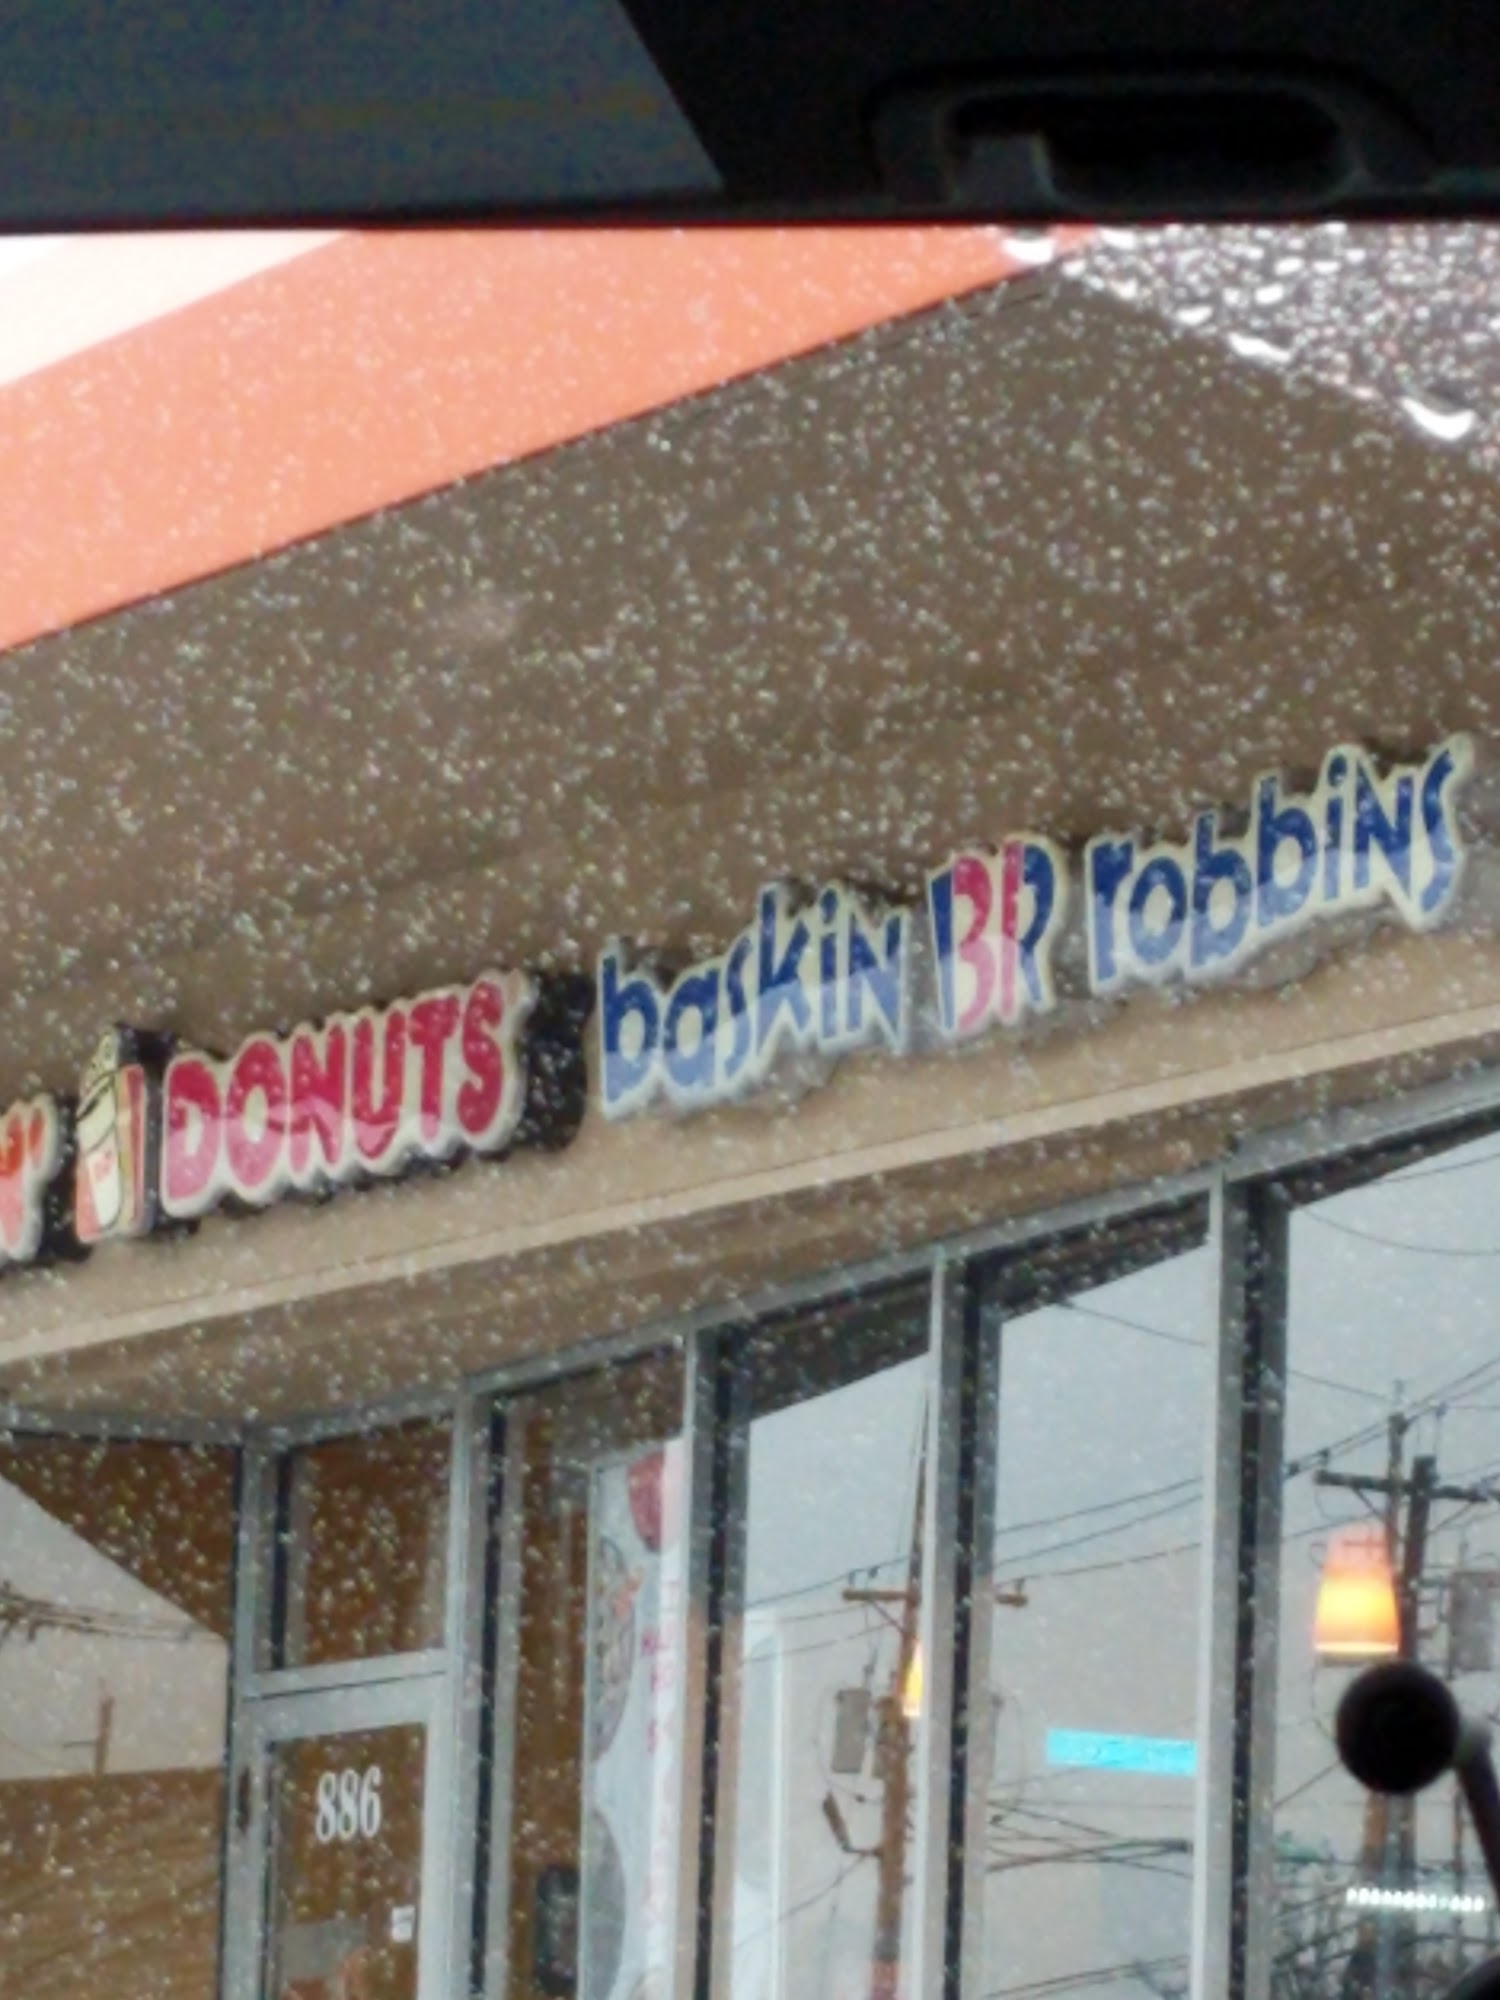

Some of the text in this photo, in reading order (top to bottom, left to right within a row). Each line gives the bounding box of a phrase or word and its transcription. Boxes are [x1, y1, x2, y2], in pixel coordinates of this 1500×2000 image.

[931, 842, 1054, 1032] BR
[165, 979, 504, 1201] DONUTS
[316, 1765, 383, 1842] 886
